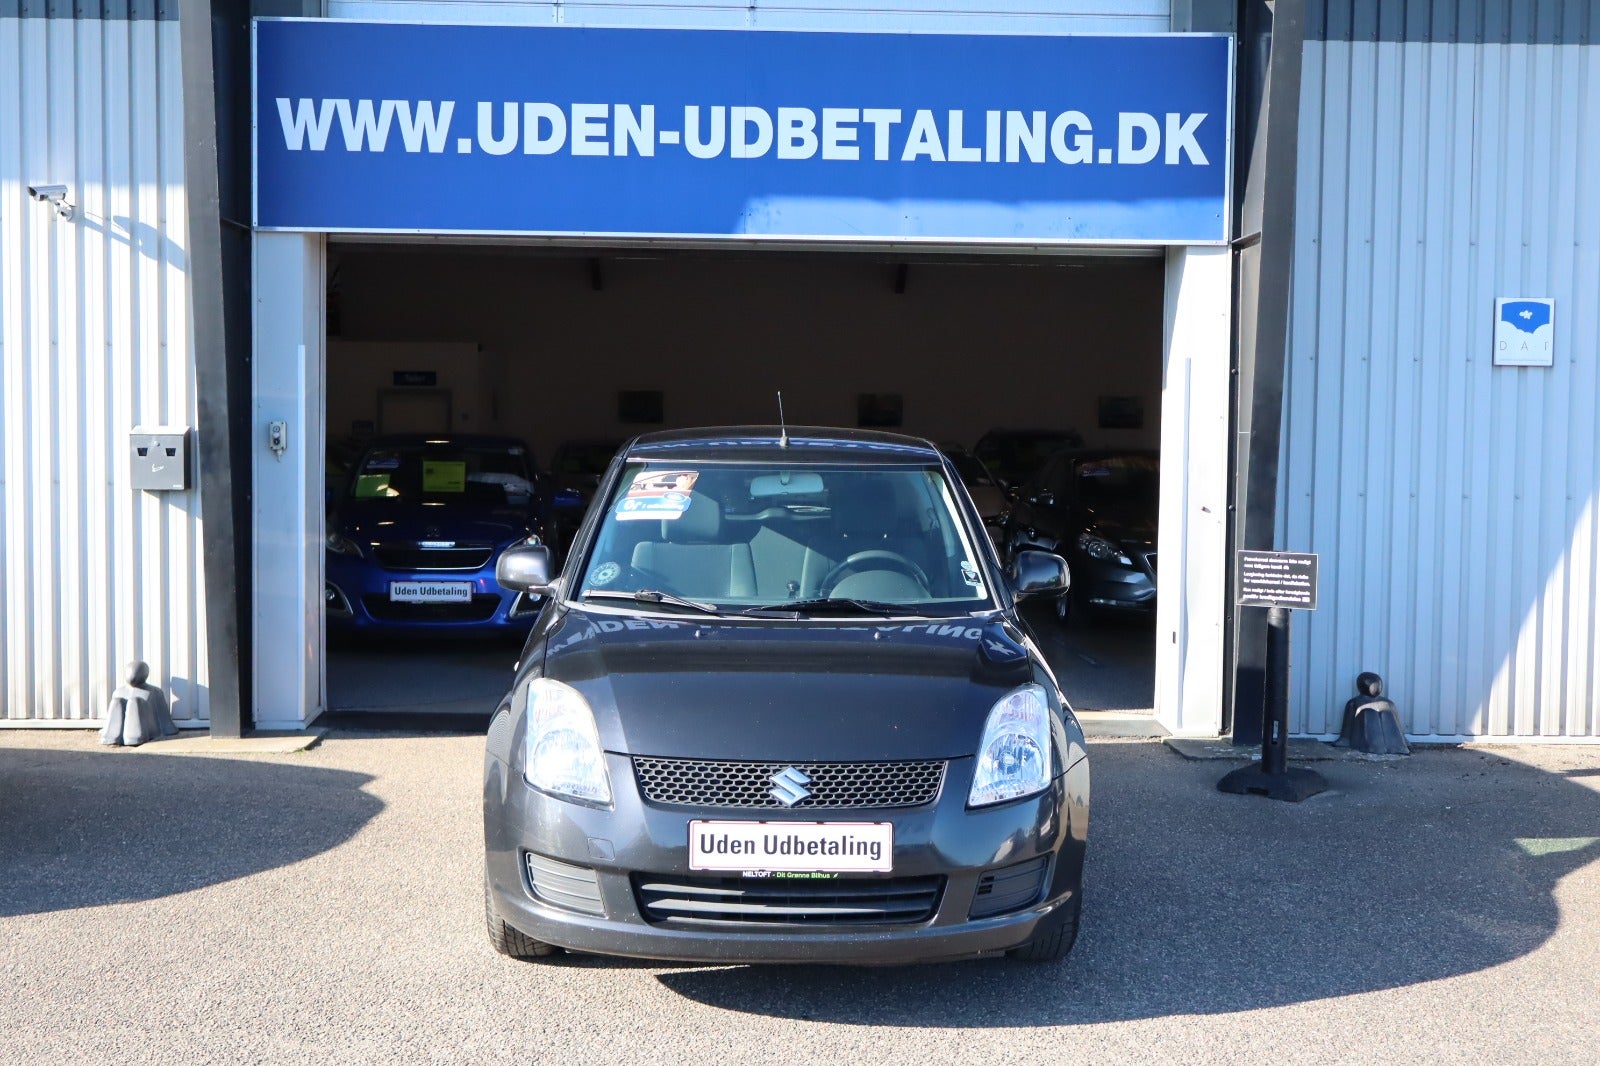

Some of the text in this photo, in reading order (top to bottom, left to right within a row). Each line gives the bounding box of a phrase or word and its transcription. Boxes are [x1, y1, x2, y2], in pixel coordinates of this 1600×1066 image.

[275, 97, 1210, 166] WWW.UDEN-UDBETALING.DK
[394, 586, 467, 597] Uden Udbetaling
[700, 833, 882, 861] Uden Udbetaling
